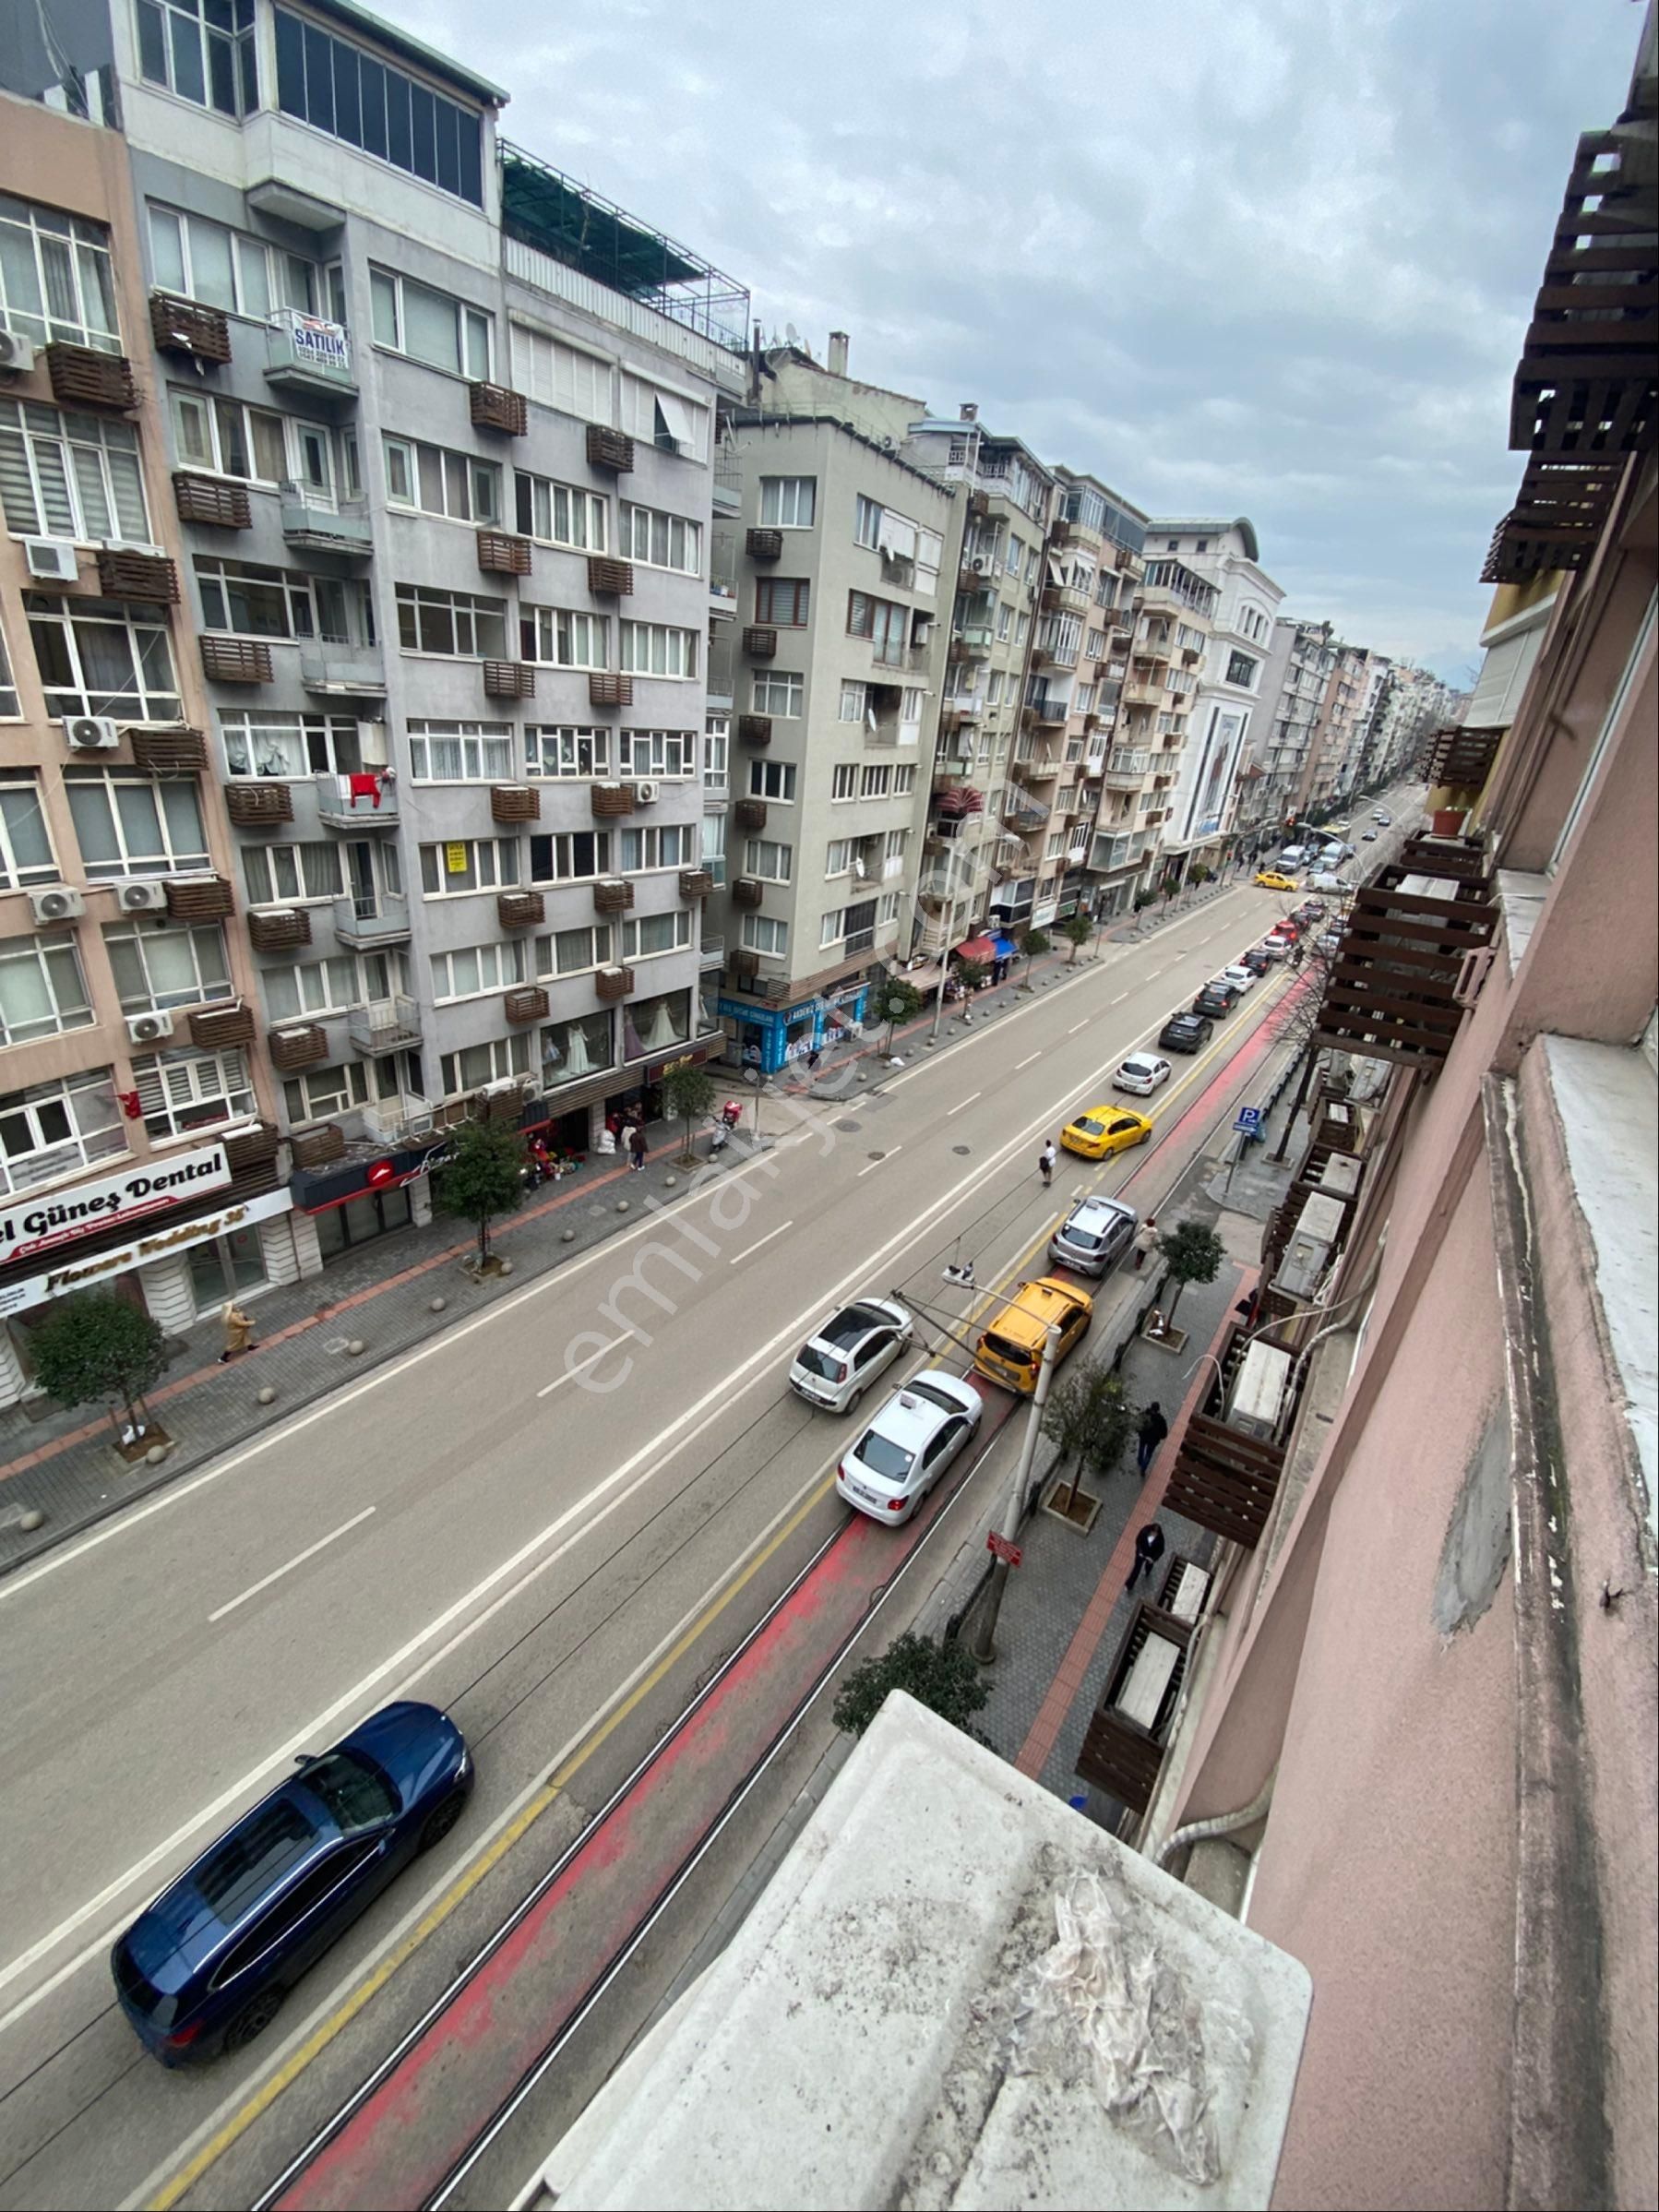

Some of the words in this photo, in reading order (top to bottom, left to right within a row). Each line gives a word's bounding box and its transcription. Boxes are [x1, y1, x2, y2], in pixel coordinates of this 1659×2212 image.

[295, 329, 345, 355] SATILIK
[1242, 1109, 1256, 1122] P
[23, 1191, 121, 1236] Güneş
[125, 1154, 222, 1199] Dental
